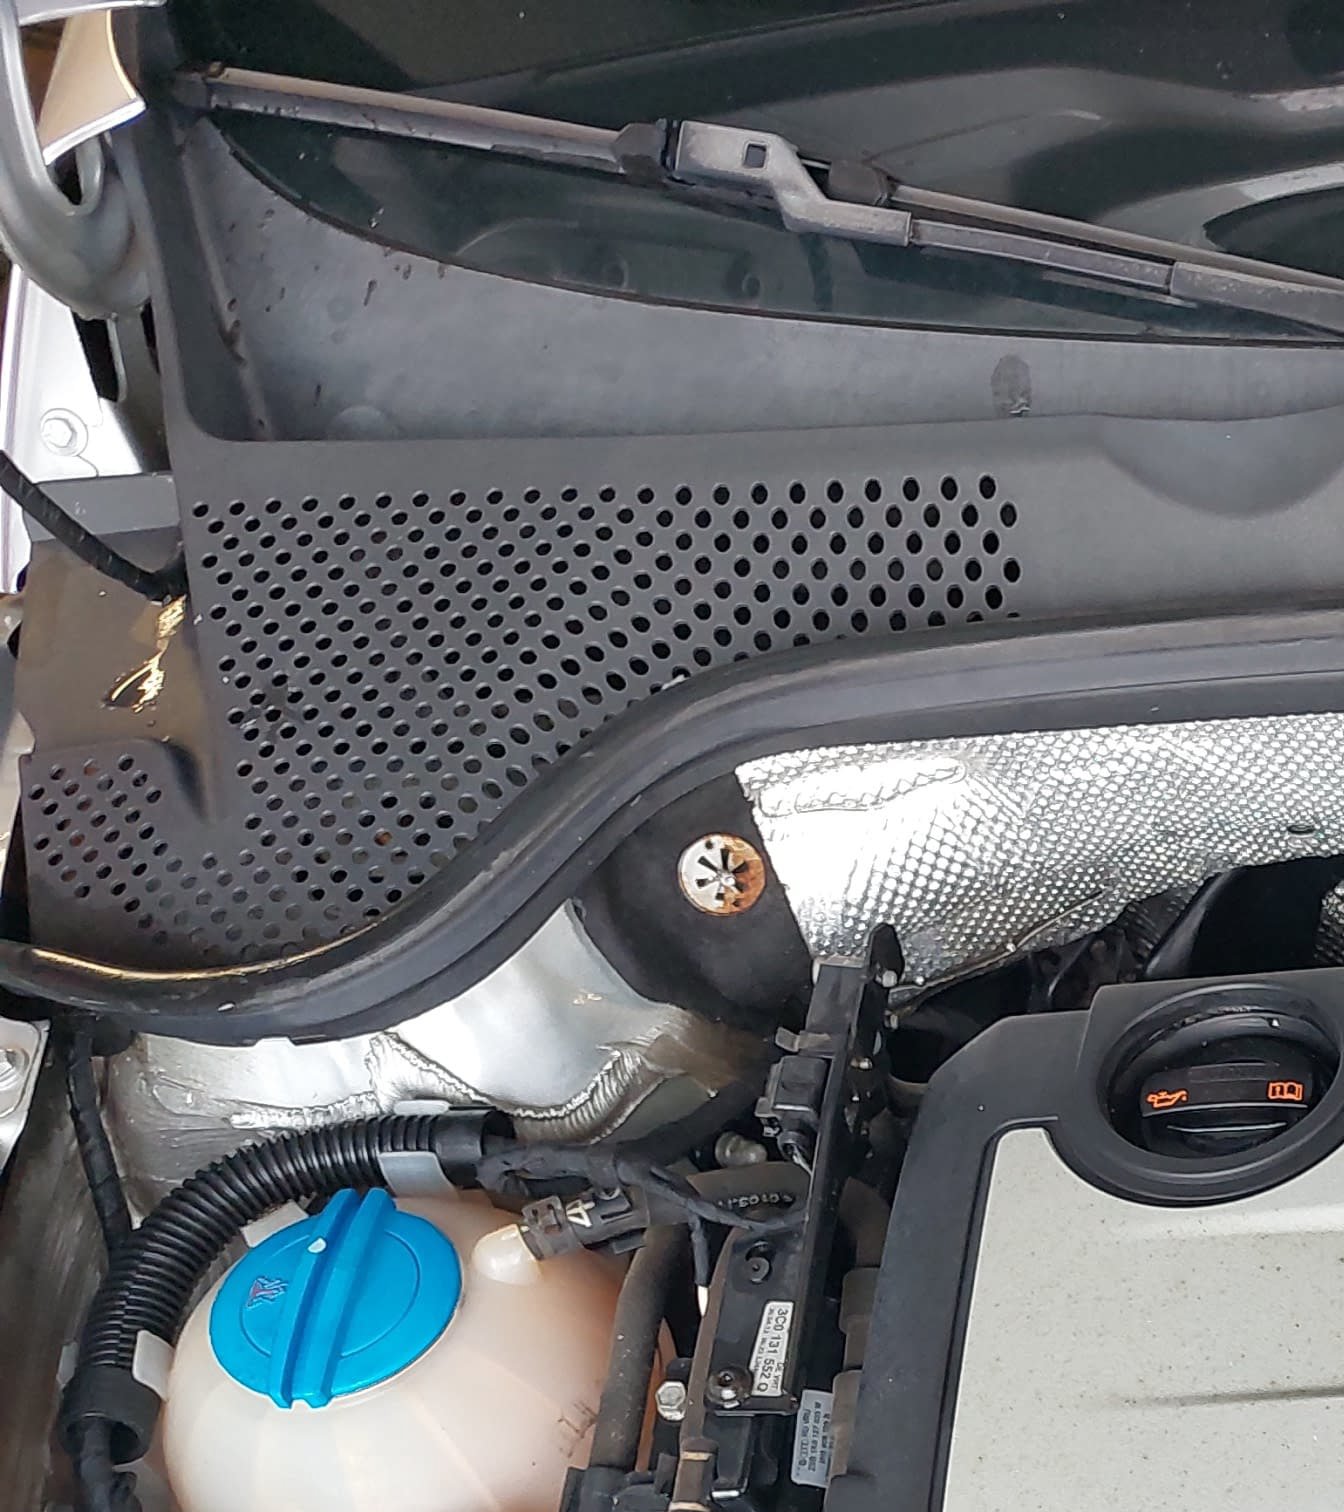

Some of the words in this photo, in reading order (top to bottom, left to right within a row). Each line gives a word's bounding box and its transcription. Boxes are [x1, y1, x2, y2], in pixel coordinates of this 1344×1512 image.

[772, 1308, 789, 1332] 3C0
[767, 1334, 783, 1354] 131
[759, 1357, 776, 1380] 552
